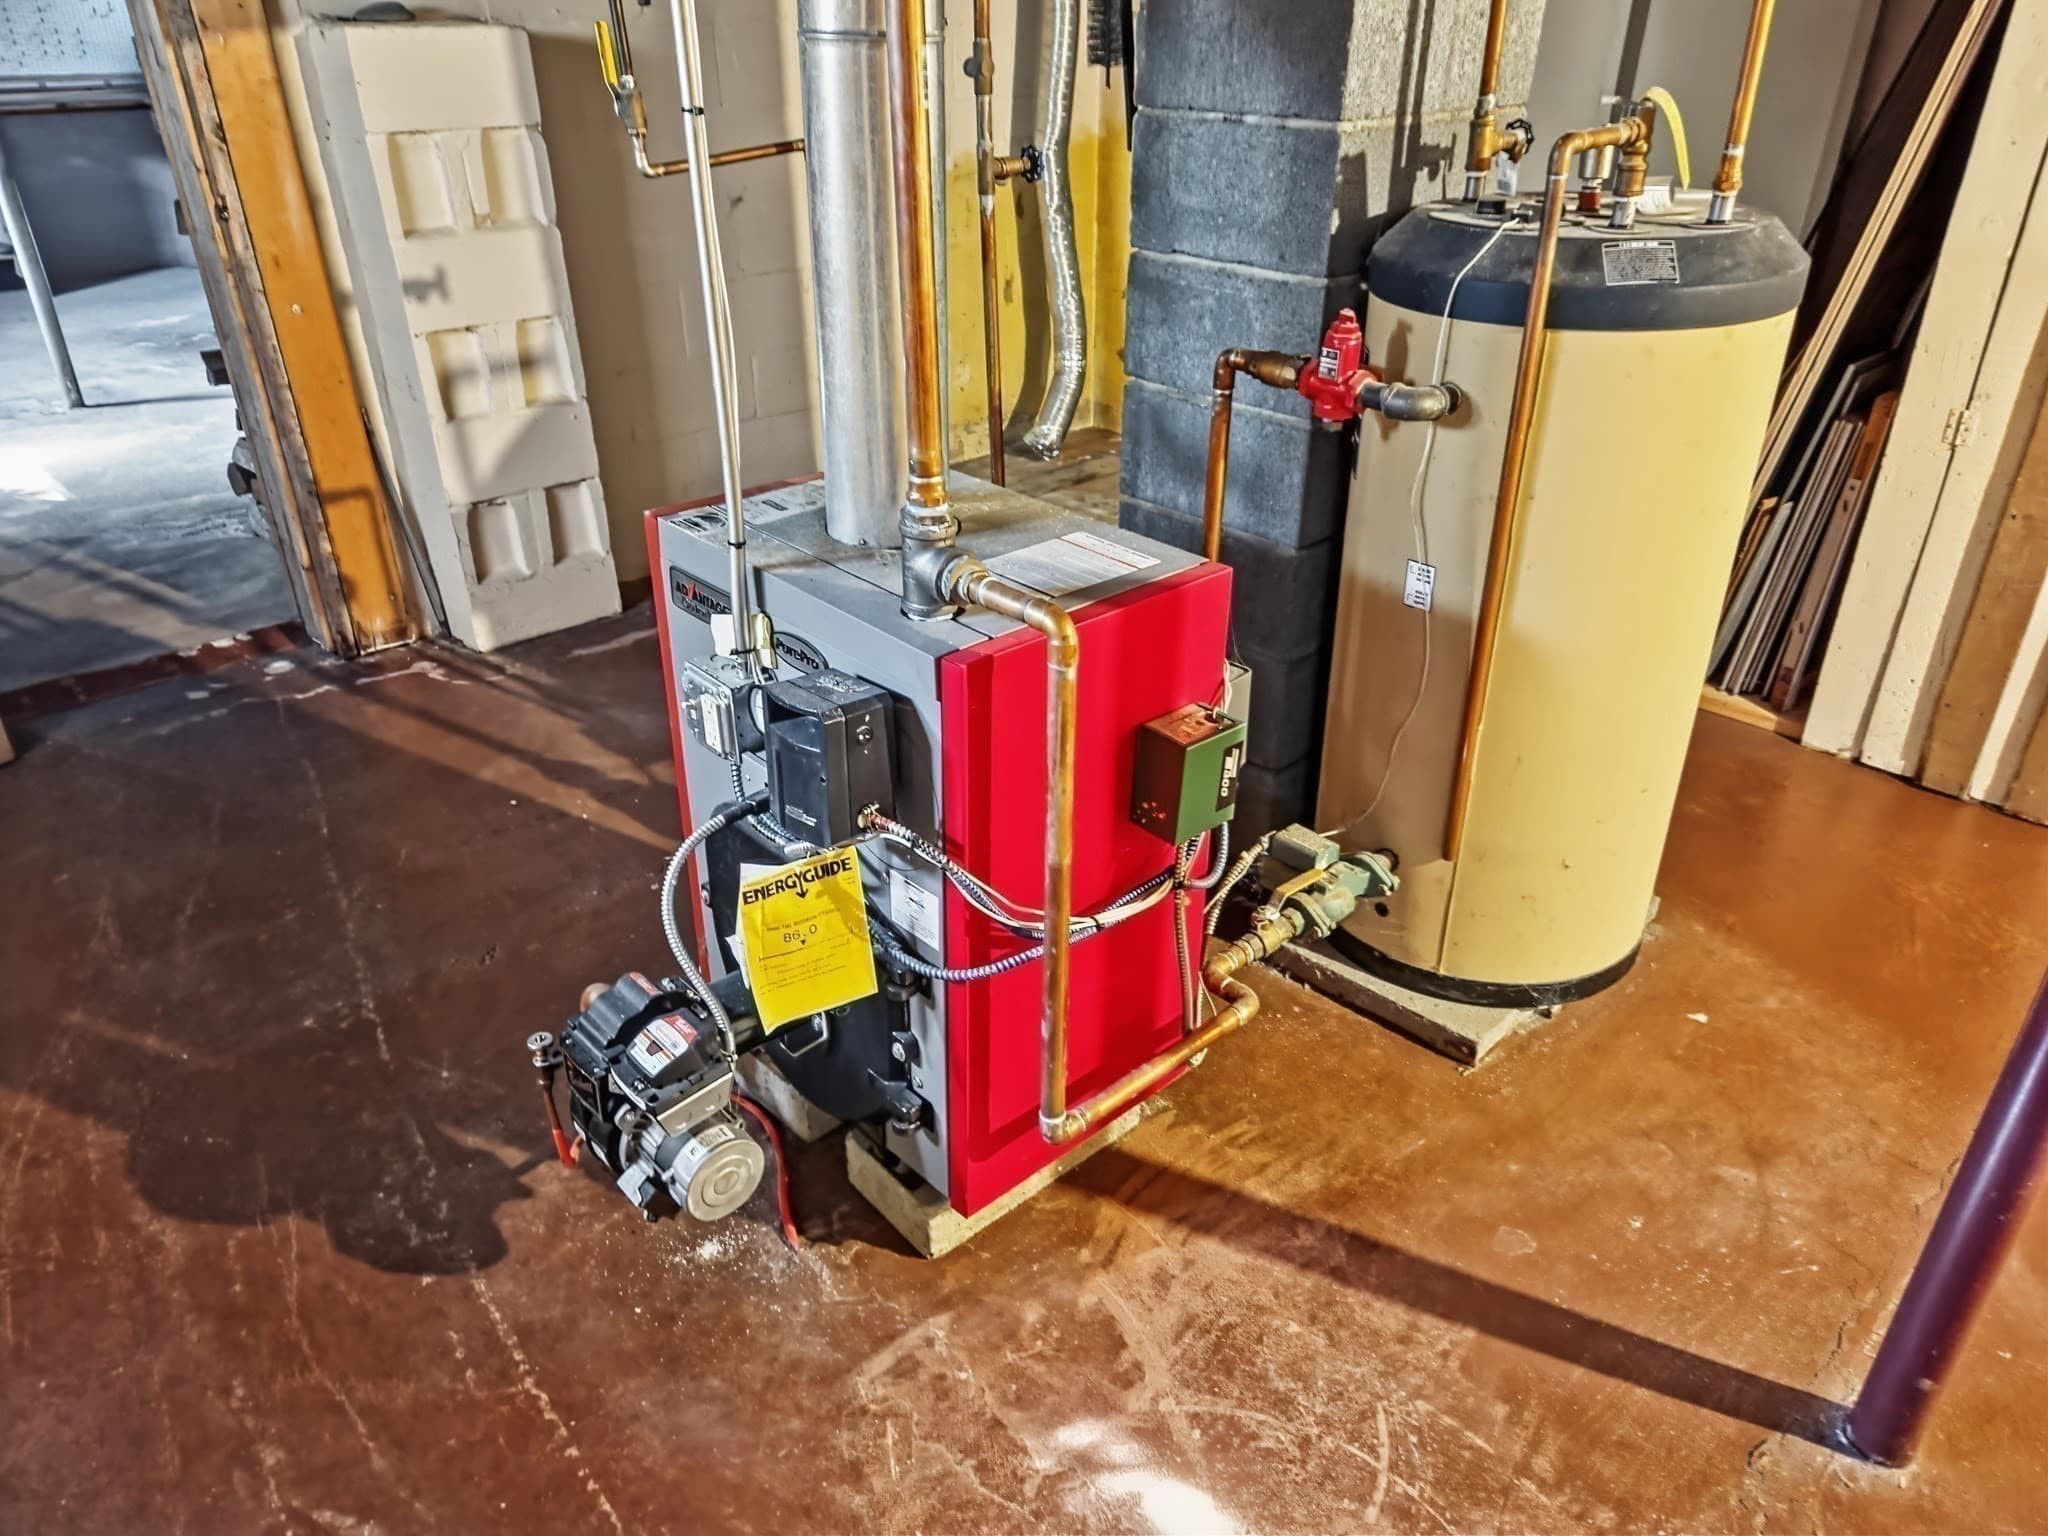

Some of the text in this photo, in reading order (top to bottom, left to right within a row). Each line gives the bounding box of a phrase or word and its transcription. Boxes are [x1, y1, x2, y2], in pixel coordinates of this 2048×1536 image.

[775, 638, 820, 670] PurePro
[742, 857, 853, 905] ENERGYGUIDE
[783, 924, 817, 943] 86.0
